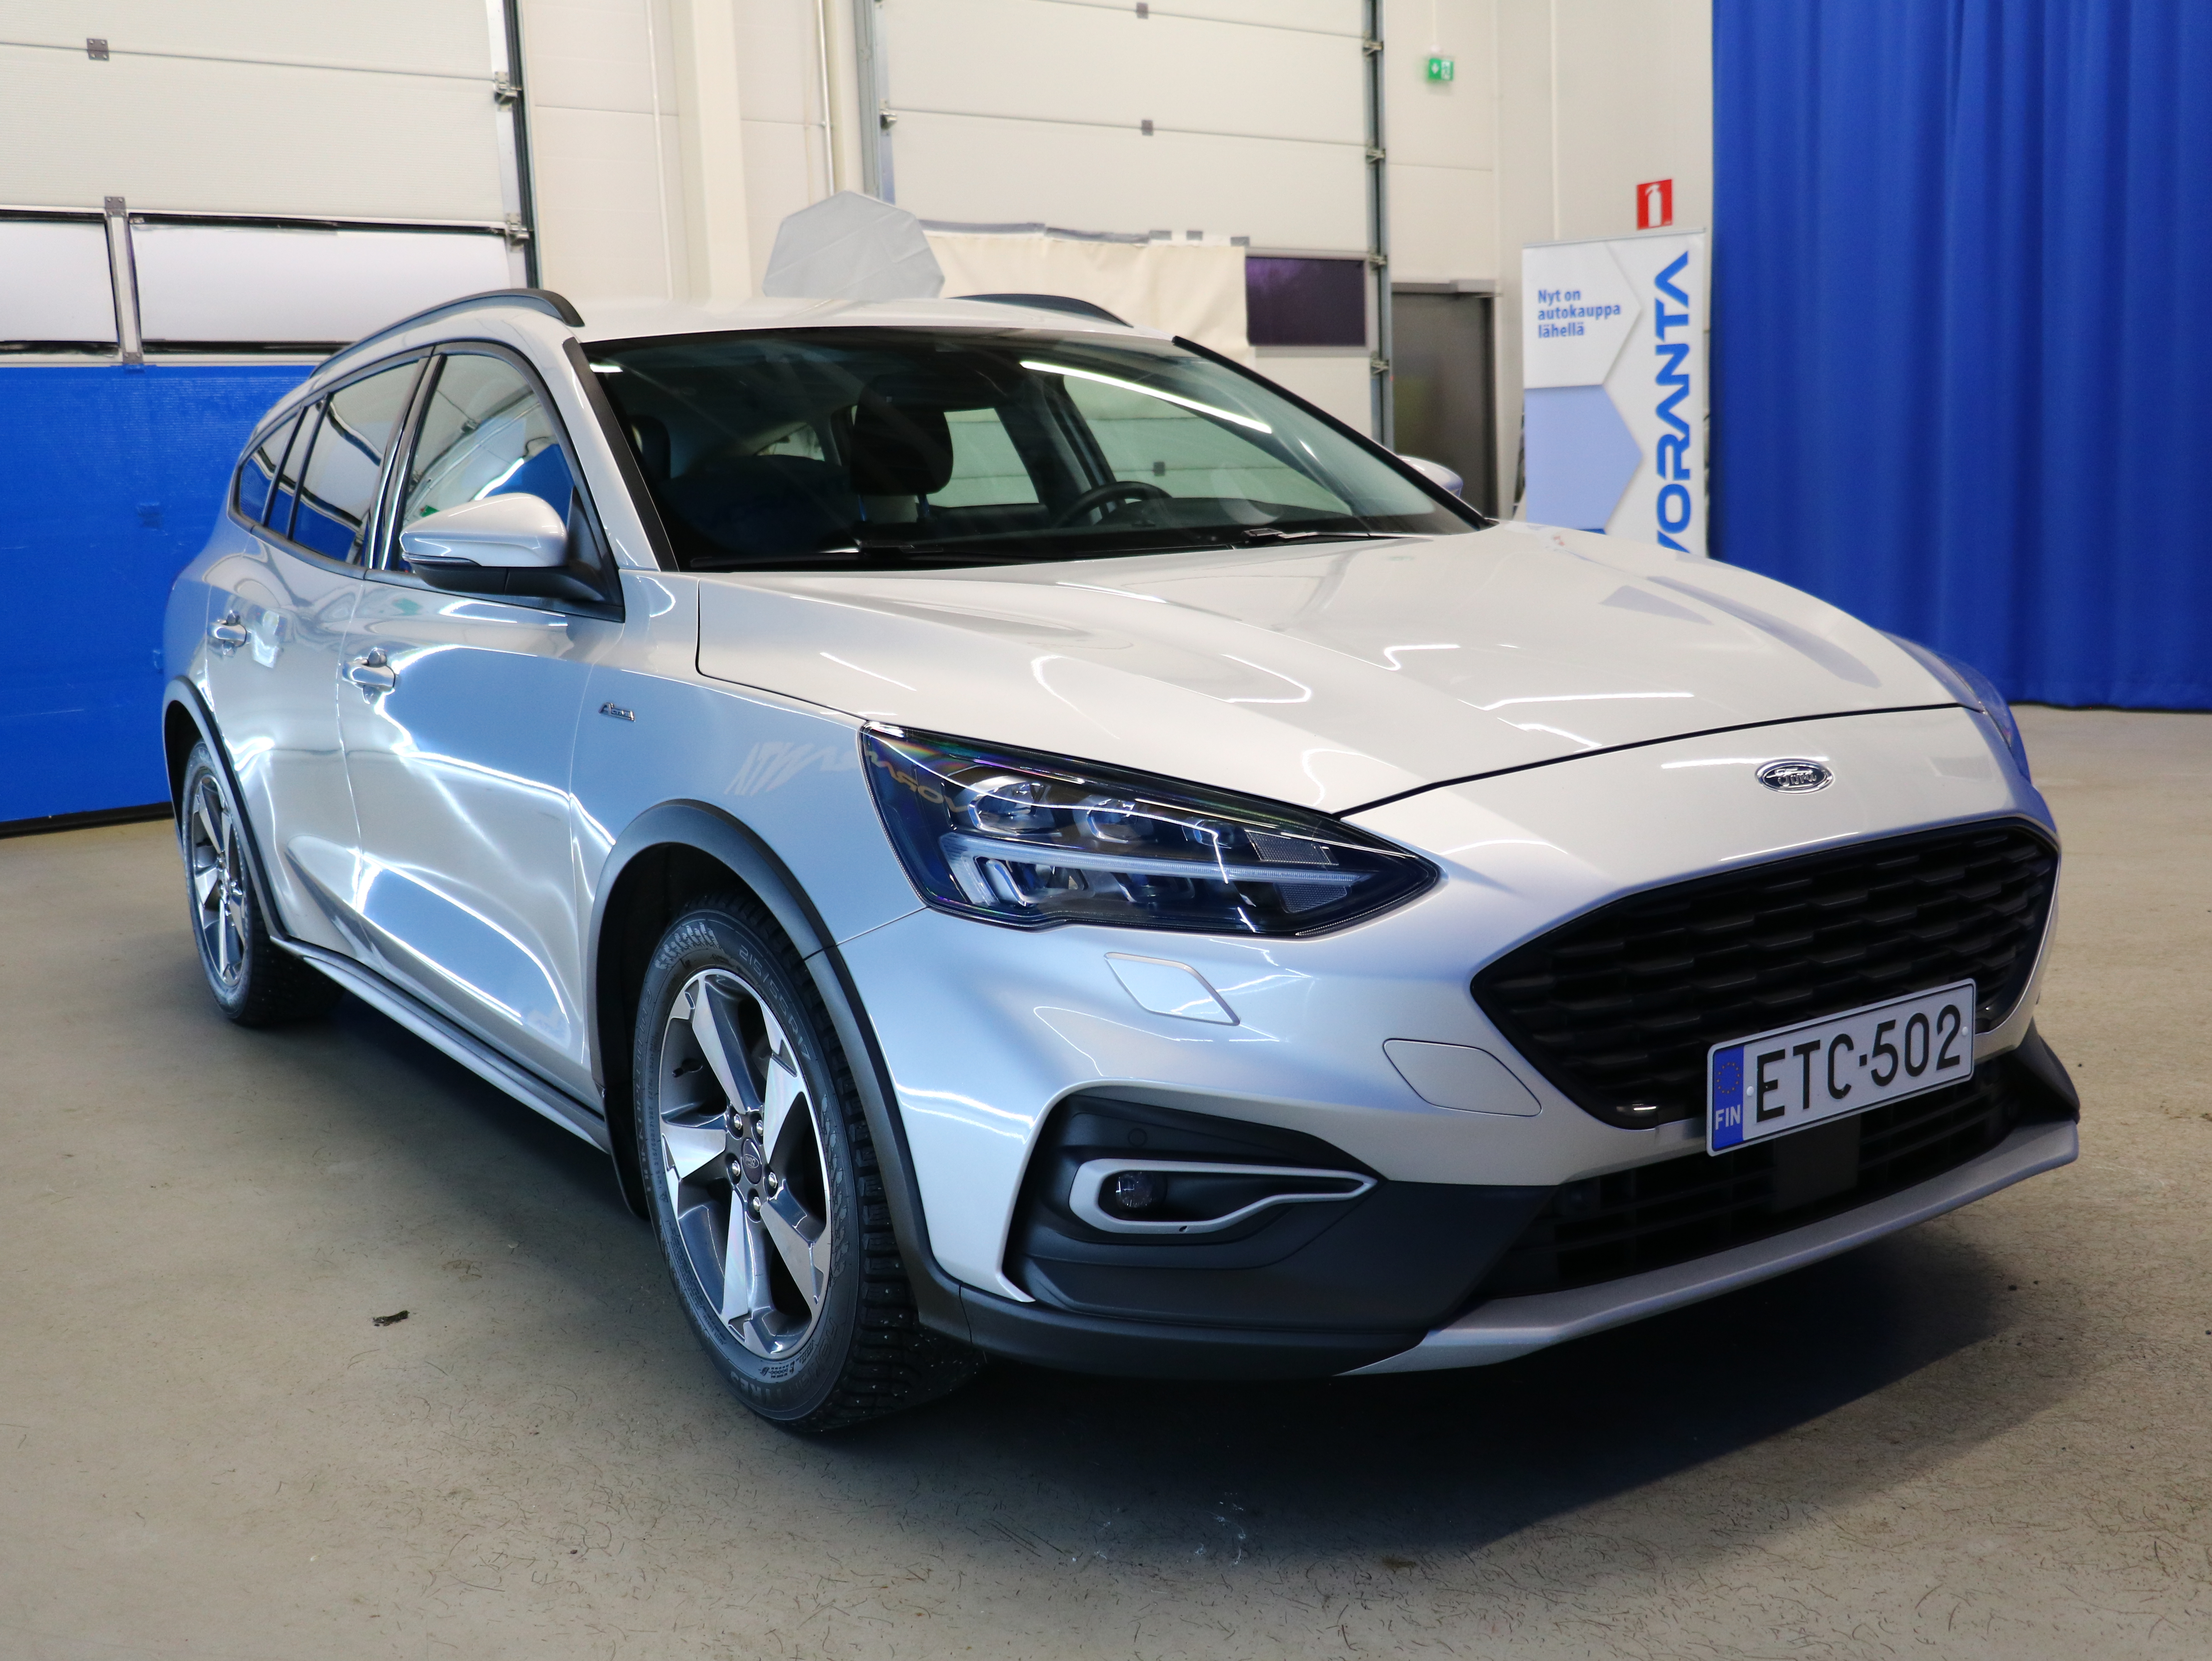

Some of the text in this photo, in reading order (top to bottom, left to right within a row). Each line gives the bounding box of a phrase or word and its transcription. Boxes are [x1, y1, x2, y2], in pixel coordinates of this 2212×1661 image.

[1538, 289, 1581, 306] Nyt on
[1538, 304, 1620, 320] autokauppa
[1538, 321, 1584, 338] lähellä
[1756, 1004, 1961, 1123] ETC-502
[1715, 1104, 1741, 1131] FIN
